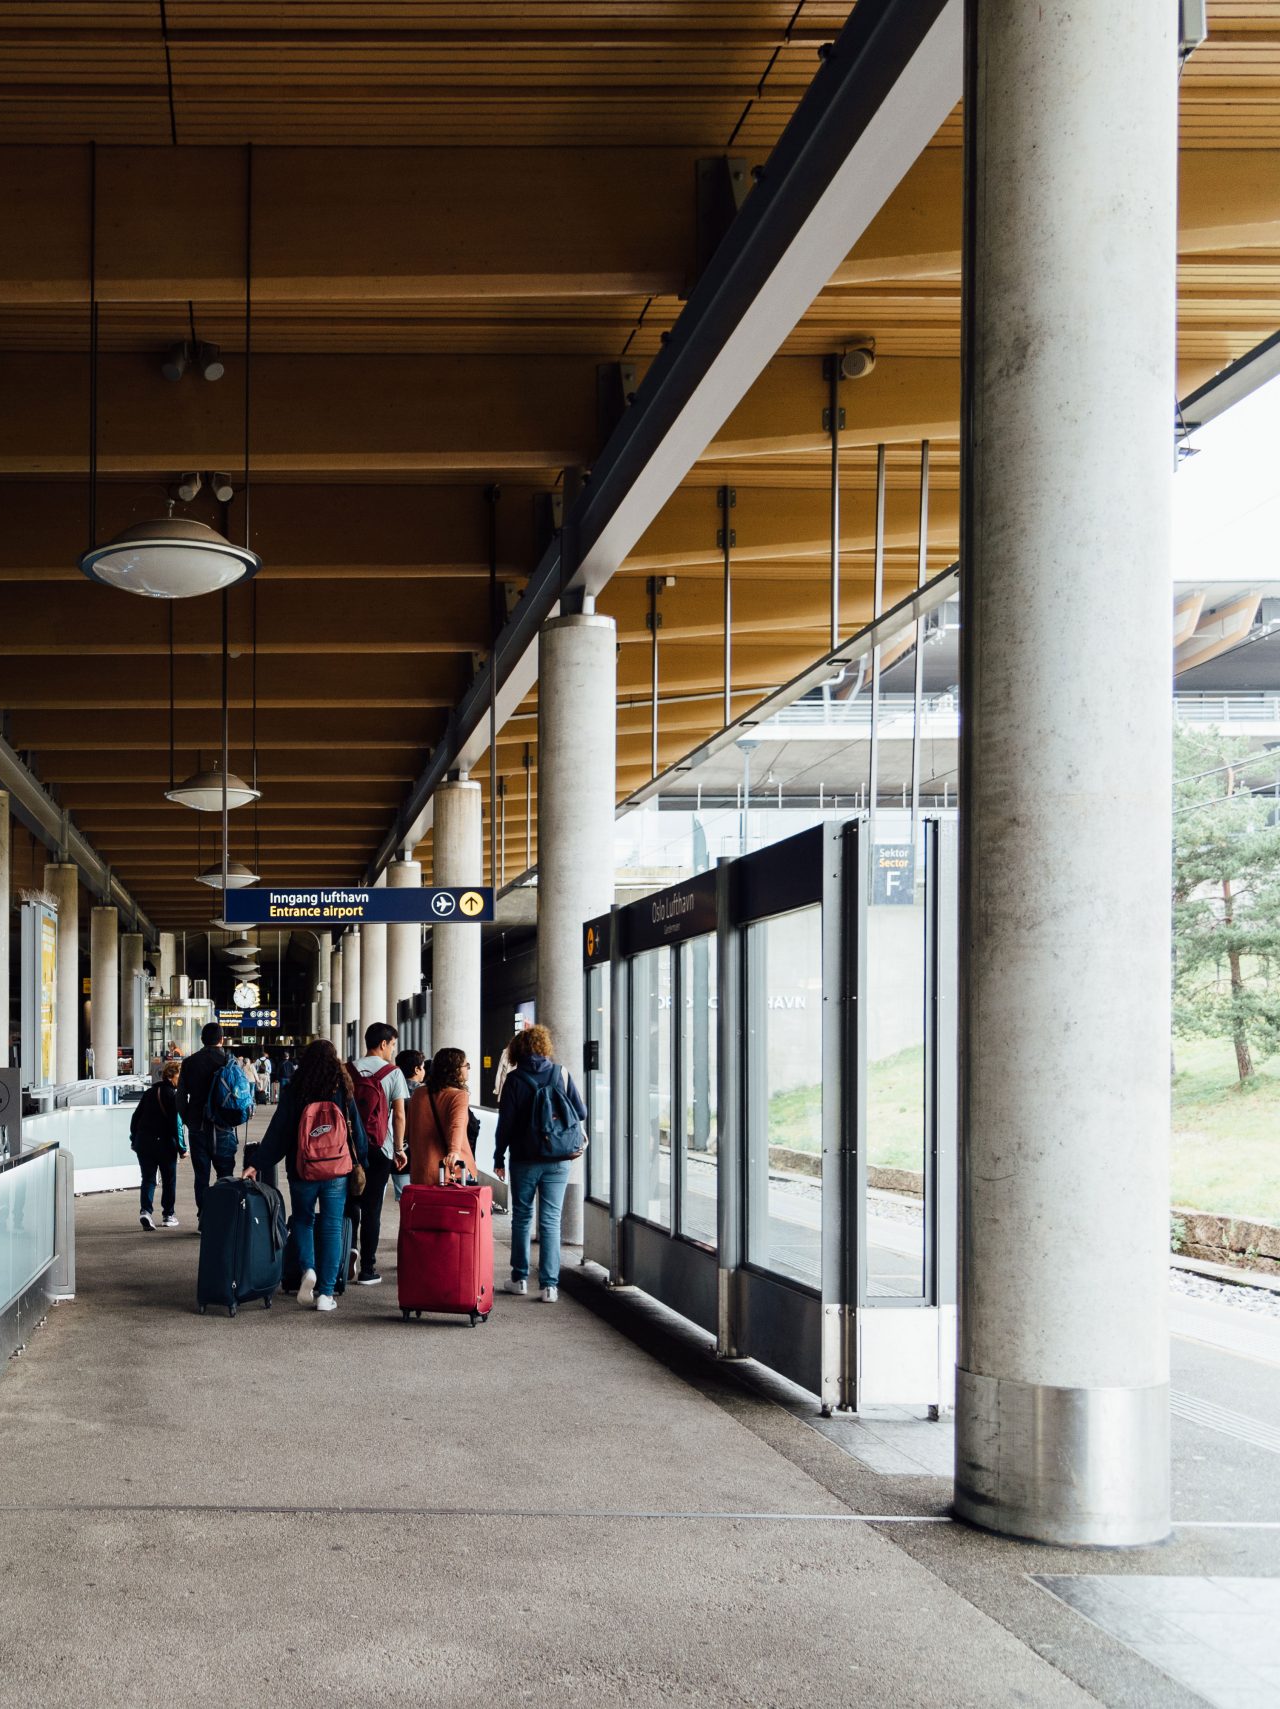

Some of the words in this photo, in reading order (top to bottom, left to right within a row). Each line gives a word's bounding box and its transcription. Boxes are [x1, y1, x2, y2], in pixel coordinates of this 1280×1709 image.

[879, 848, 909, 858] Sektor
[879, 858, 909, 868] Sector
[886, 870, 901, 896] F
[269, 892, 318, 906] Inngang
[320, 891, 369, 903] lufthavn
[269, 906, 321, 917] Entrance
[322, 905, 364, 919] airport
[651, 898, 665, 923] Oslo
[666, 892, 695, 919] Lufthavn
